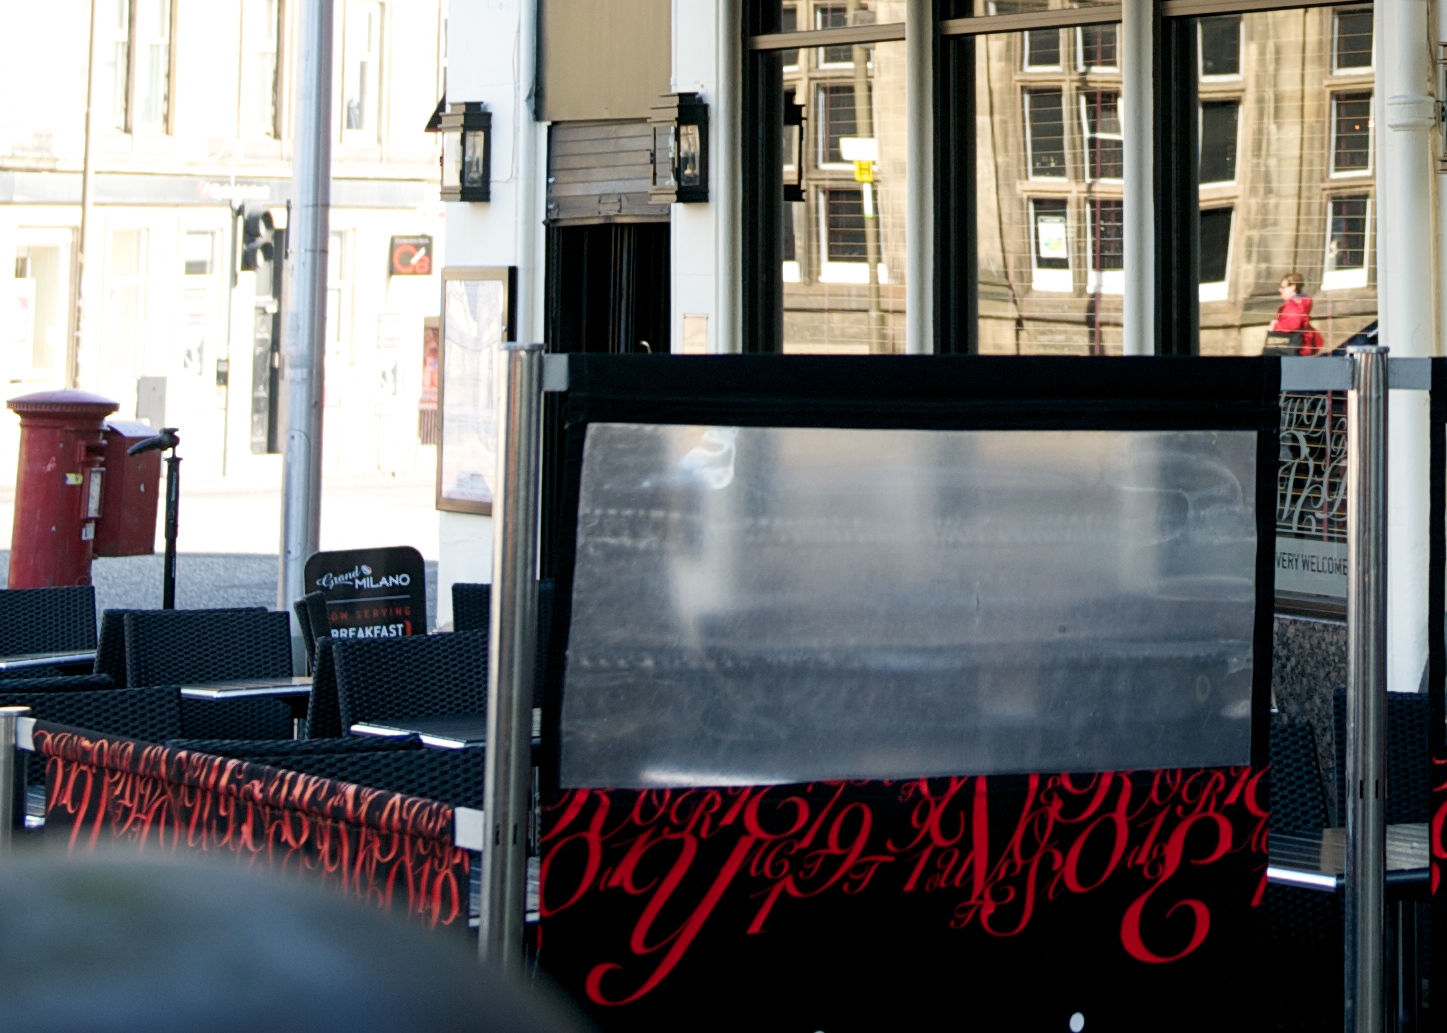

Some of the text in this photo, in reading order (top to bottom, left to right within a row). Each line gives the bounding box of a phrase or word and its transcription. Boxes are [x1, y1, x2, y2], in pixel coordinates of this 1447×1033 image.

[1301, 553, 1347, 576] WELCOME
[316, 565, 411, 589] Grand MILANO
[331, 606, 411, 622] OW SERVING
[330, 623, 404, 638] BREAKFAST
